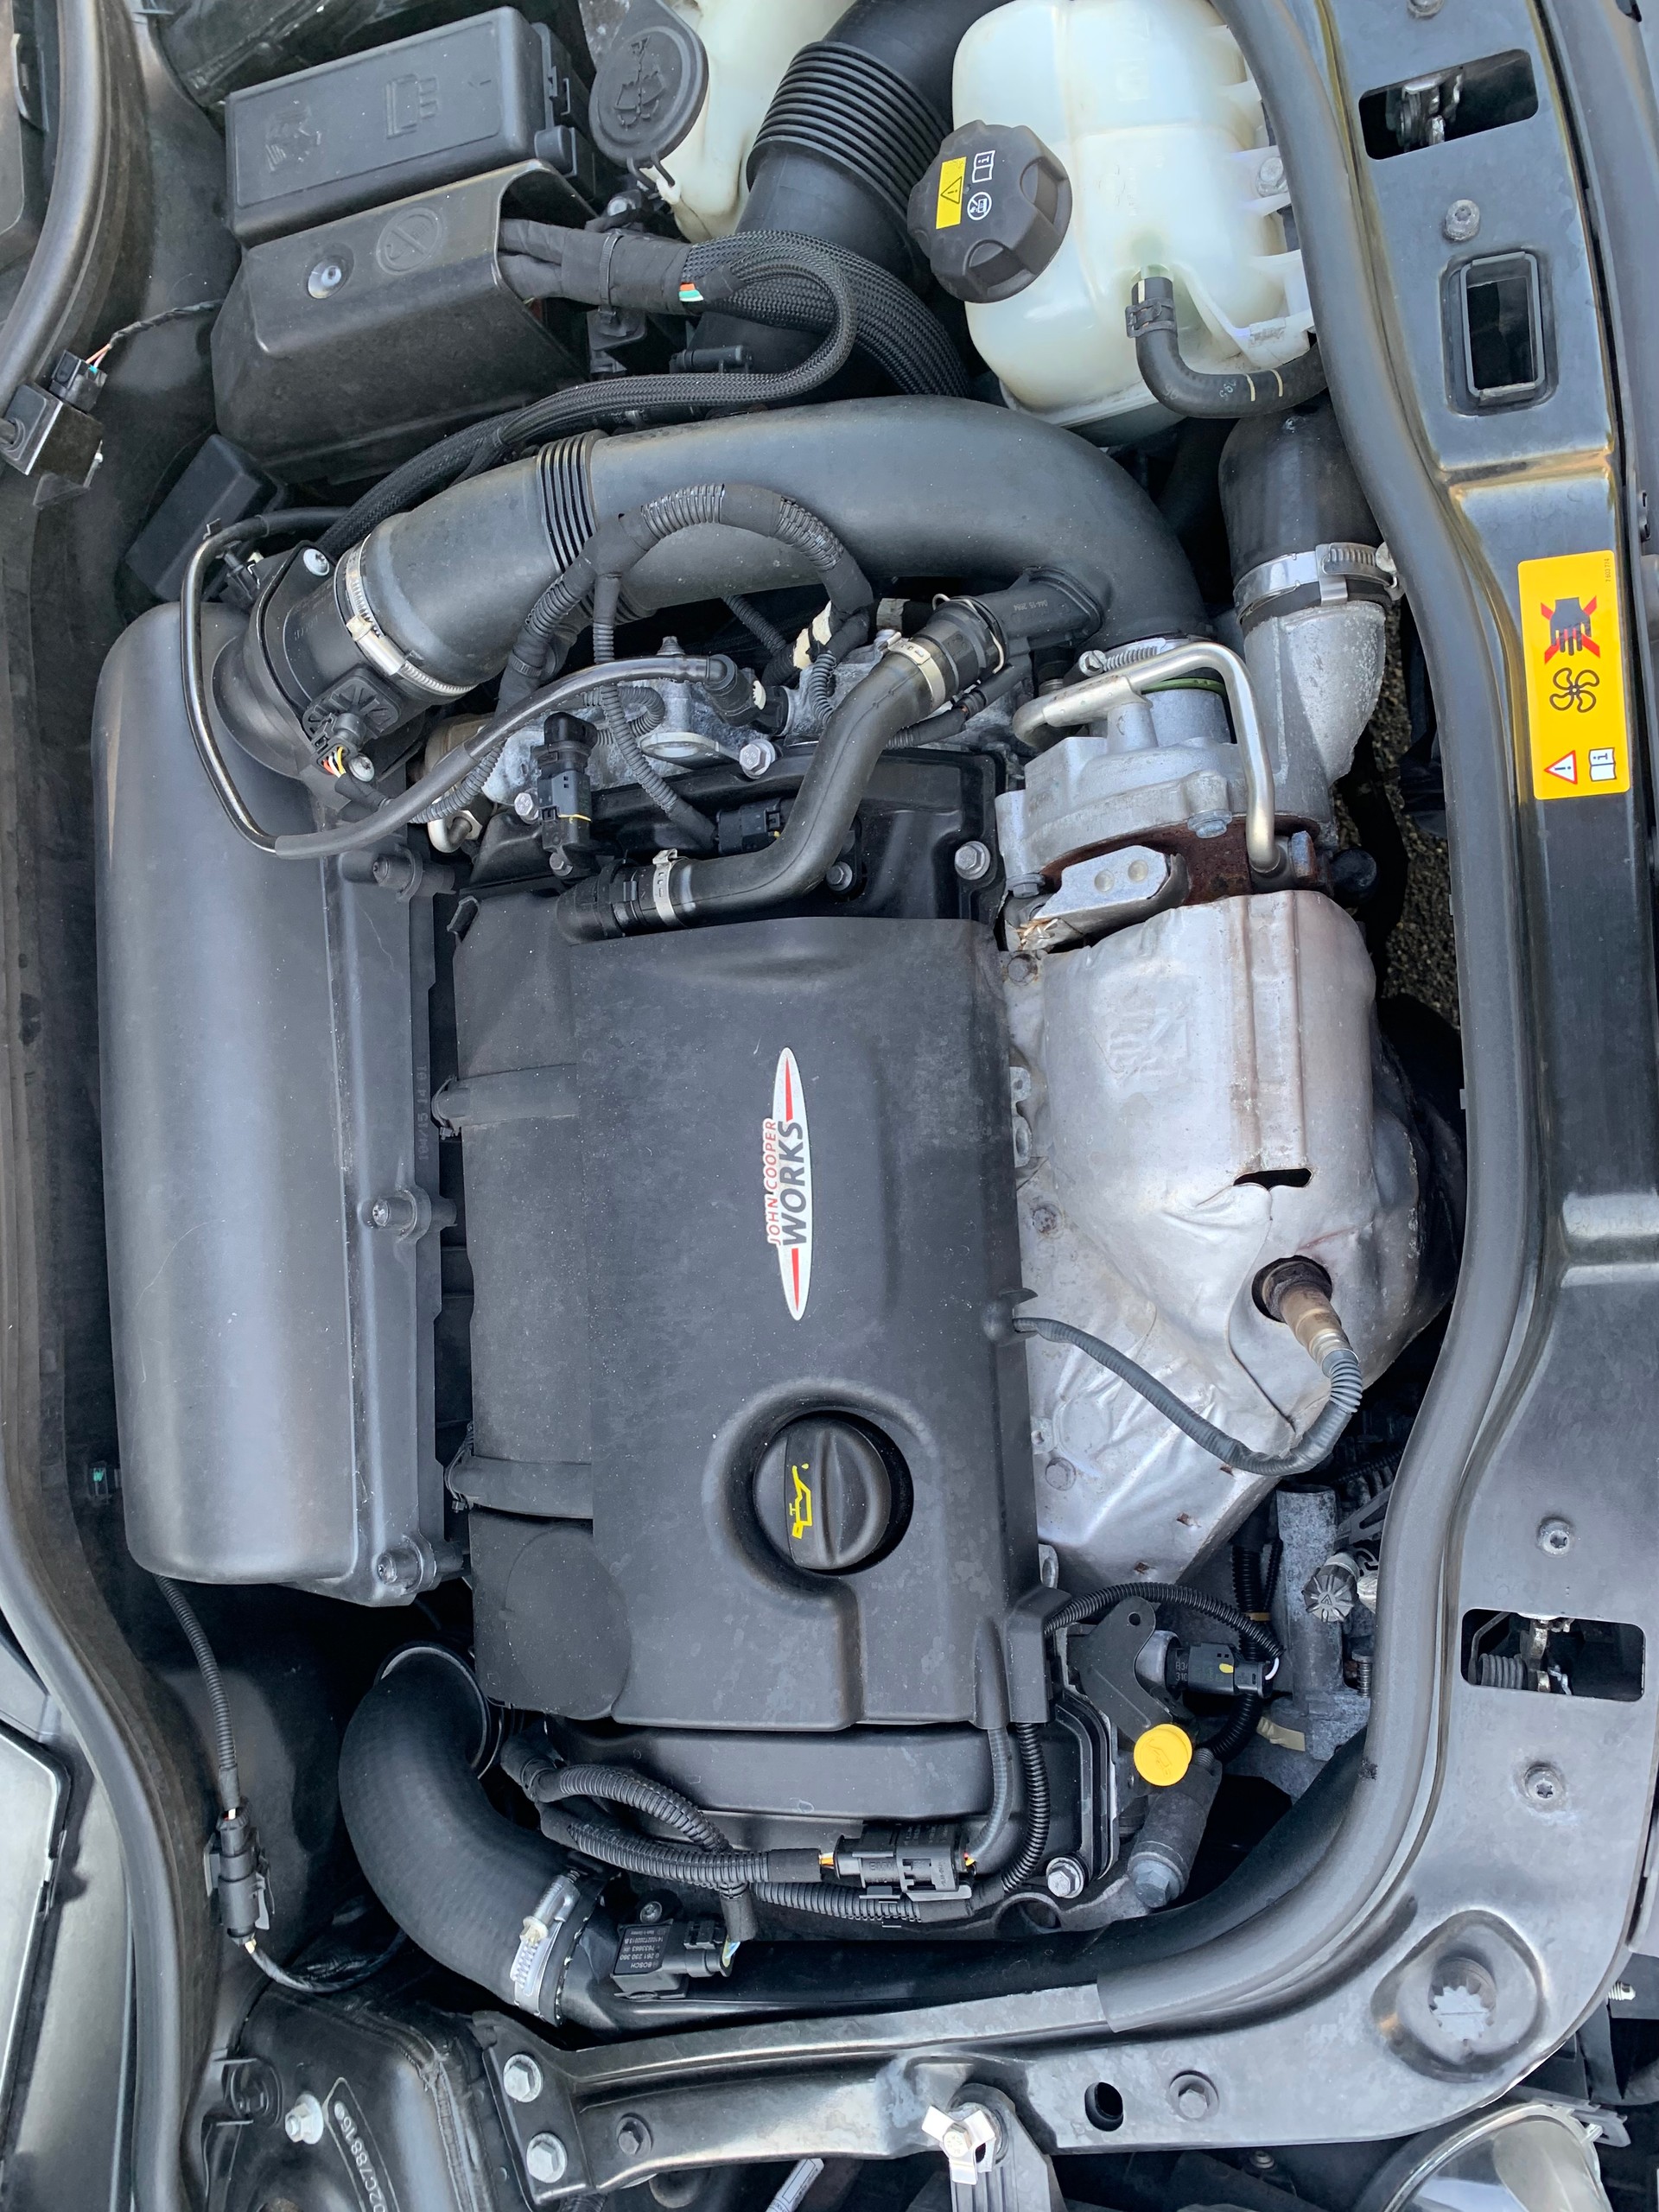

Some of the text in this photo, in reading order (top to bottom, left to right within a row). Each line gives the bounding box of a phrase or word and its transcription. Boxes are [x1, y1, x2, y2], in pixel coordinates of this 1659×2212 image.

[765, 1122, 781, 1245] JOHN COOPER
[778, 1121, 807, 1245] WORKS
